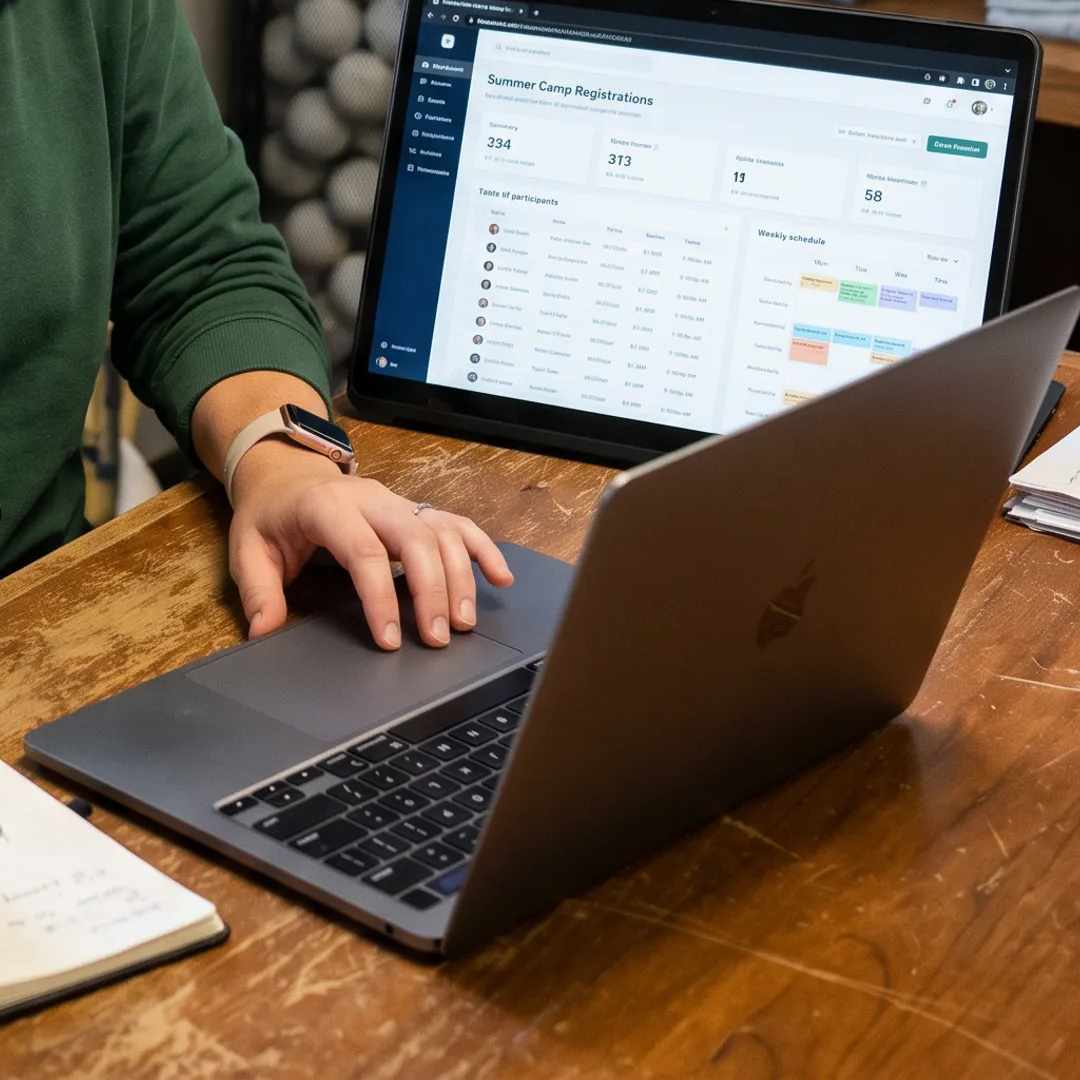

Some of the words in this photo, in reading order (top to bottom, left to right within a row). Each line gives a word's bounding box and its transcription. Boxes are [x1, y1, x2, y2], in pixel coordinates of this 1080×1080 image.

[487, 73, 536, 90] Summer
[538, 81, 572, 96] Camp
[574, 85, 654, 106] Registrations
[487, 136, 512, 150] 334
[607, 153, 632, 167] 313
[511, 193, 559, 206] participants
[864, 189, 883, 202] 58
[757, 228, 787, 241] Weekly
[788, 232, 826, 246] schedule
